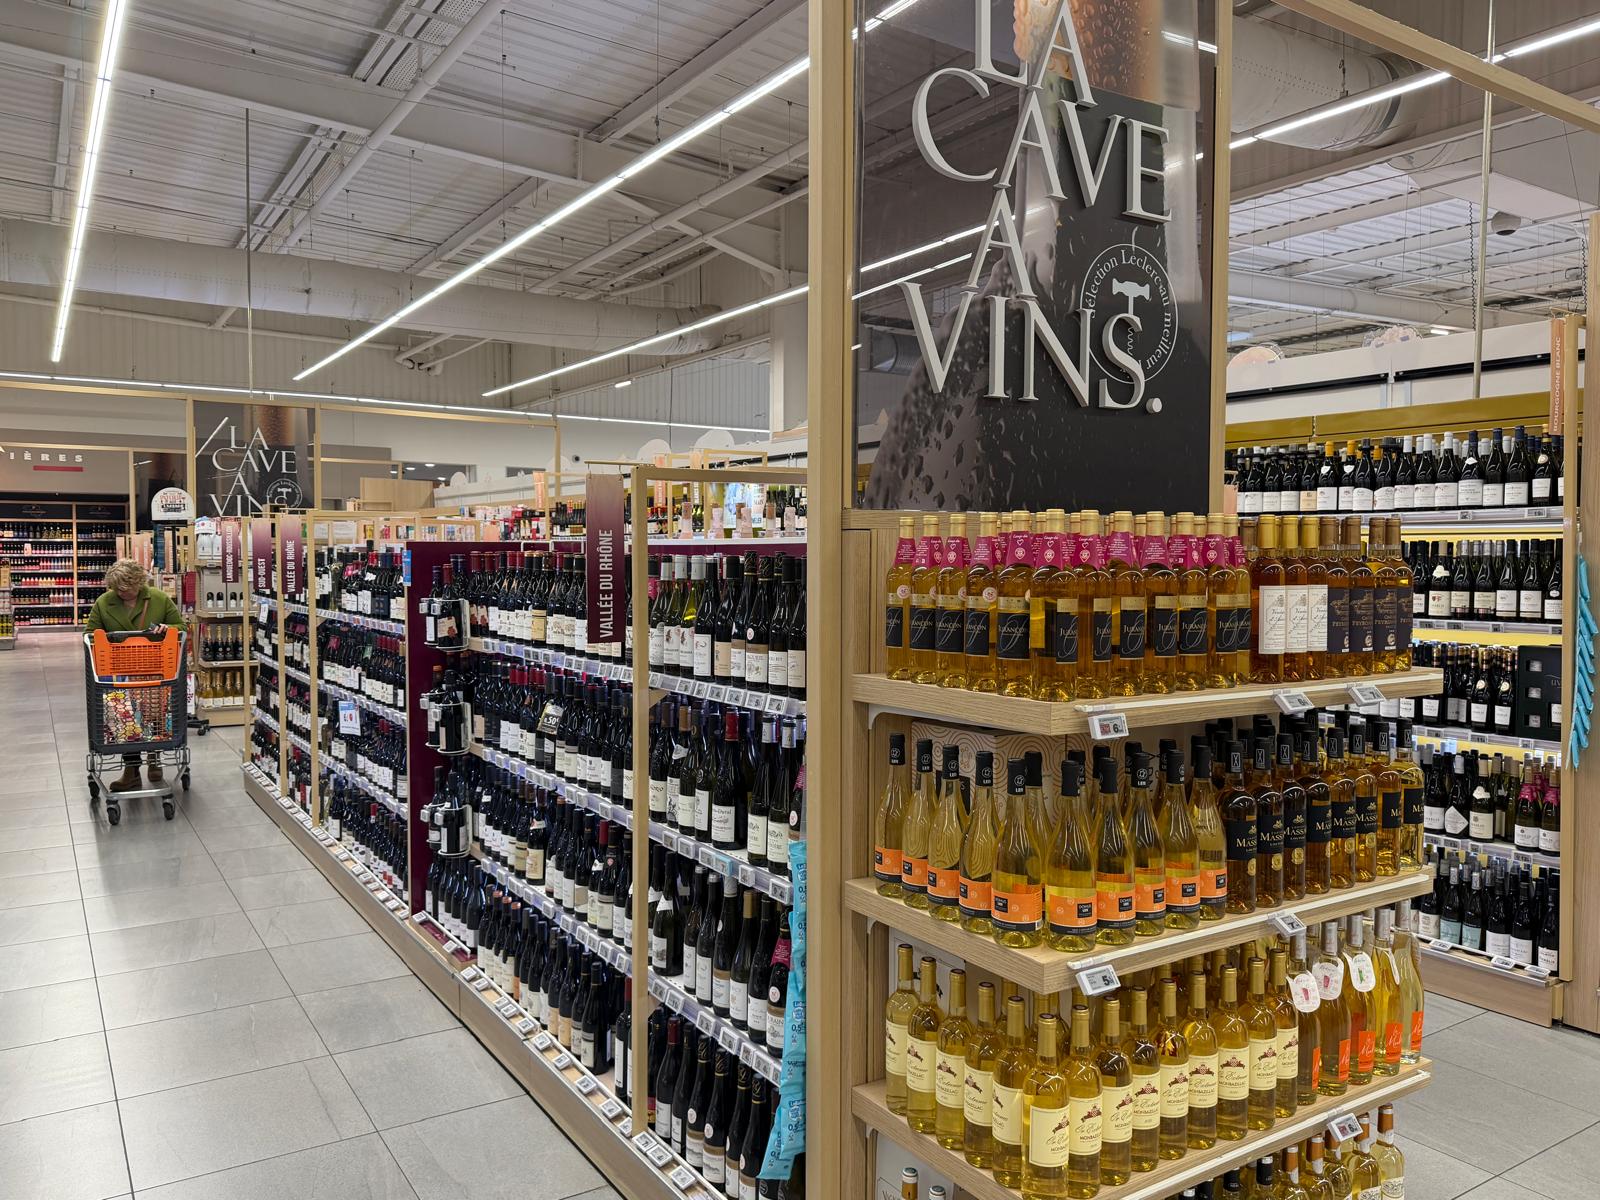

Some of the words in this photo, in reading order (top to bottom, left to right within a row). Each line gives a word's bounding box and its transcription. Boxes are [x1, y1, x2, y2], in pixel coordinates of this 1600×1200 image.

[974, 0, 1099, 109] LA
[912, 67, 1173, 224] CAVE
[959, 188, 1040, 300] A
[1121, 249, 1162, 286] Leclerc
[1145, 312, 1172, 371] meilleur
[899, 280, 1164, 416] VINS.
[229, 425, 270, 451] LA
[212, 447, 298, 474] CAVE
[228, 471, 252, 496] A
[285, 540, 295, 560] RHÔNE
[596, 529, 613, 571] RHÔNE
[257, 557, 266, 588] SUD-OUEST
[285, 570, 296, 593] VALLÉE
[599, 574, 613, 590] DU
[596, 593, 614, 638] VALLÉE
